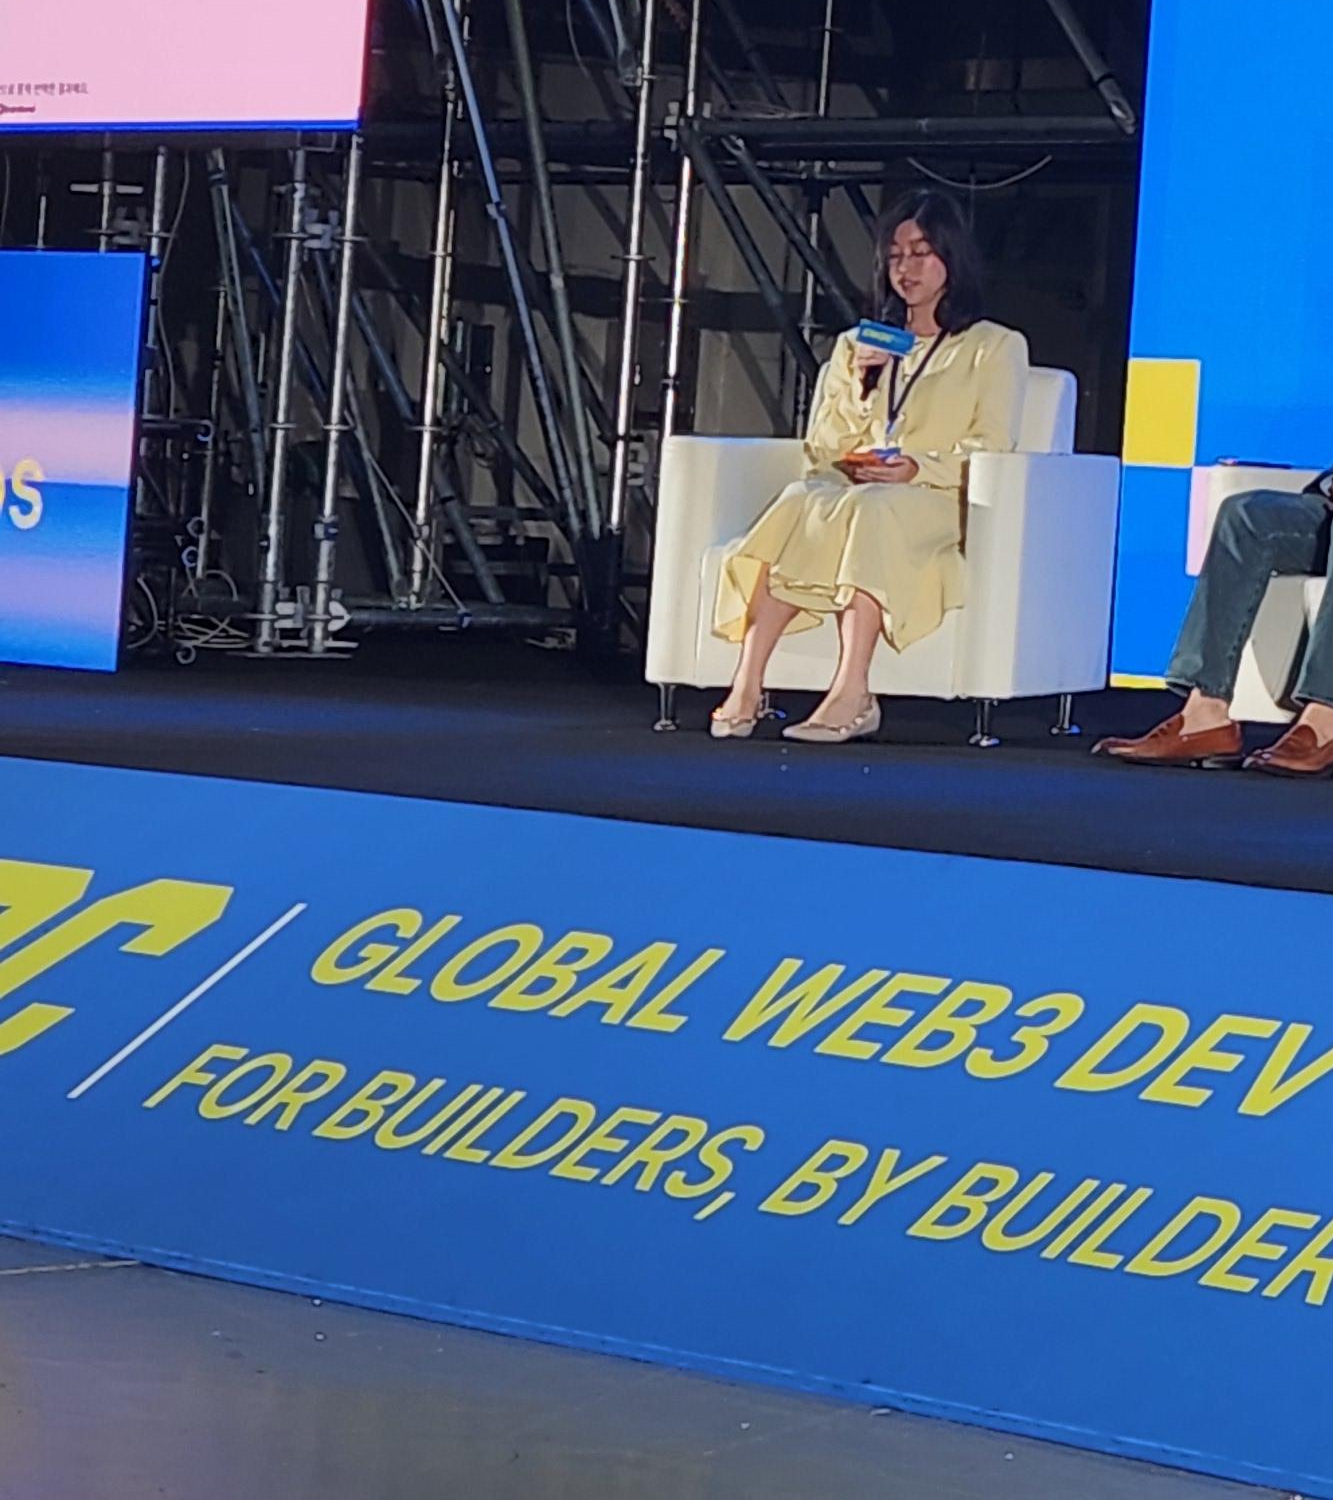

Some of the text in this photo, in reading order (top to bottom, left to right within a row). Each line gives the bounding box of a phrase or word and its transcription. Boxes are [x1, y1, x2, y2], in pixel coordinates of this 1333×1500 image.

[0, 457, 44, 529] S
[0, 858, 234, 1056] C
[307, 905, 727, 1035] GLOBAL
[720, 956, 1085, 1082] WEB3
[142, 1042, 335, 1134] FOR
[312, 1081, 768, 1222] BUILDERS,
[758, 1136, 948, 1228] BY
